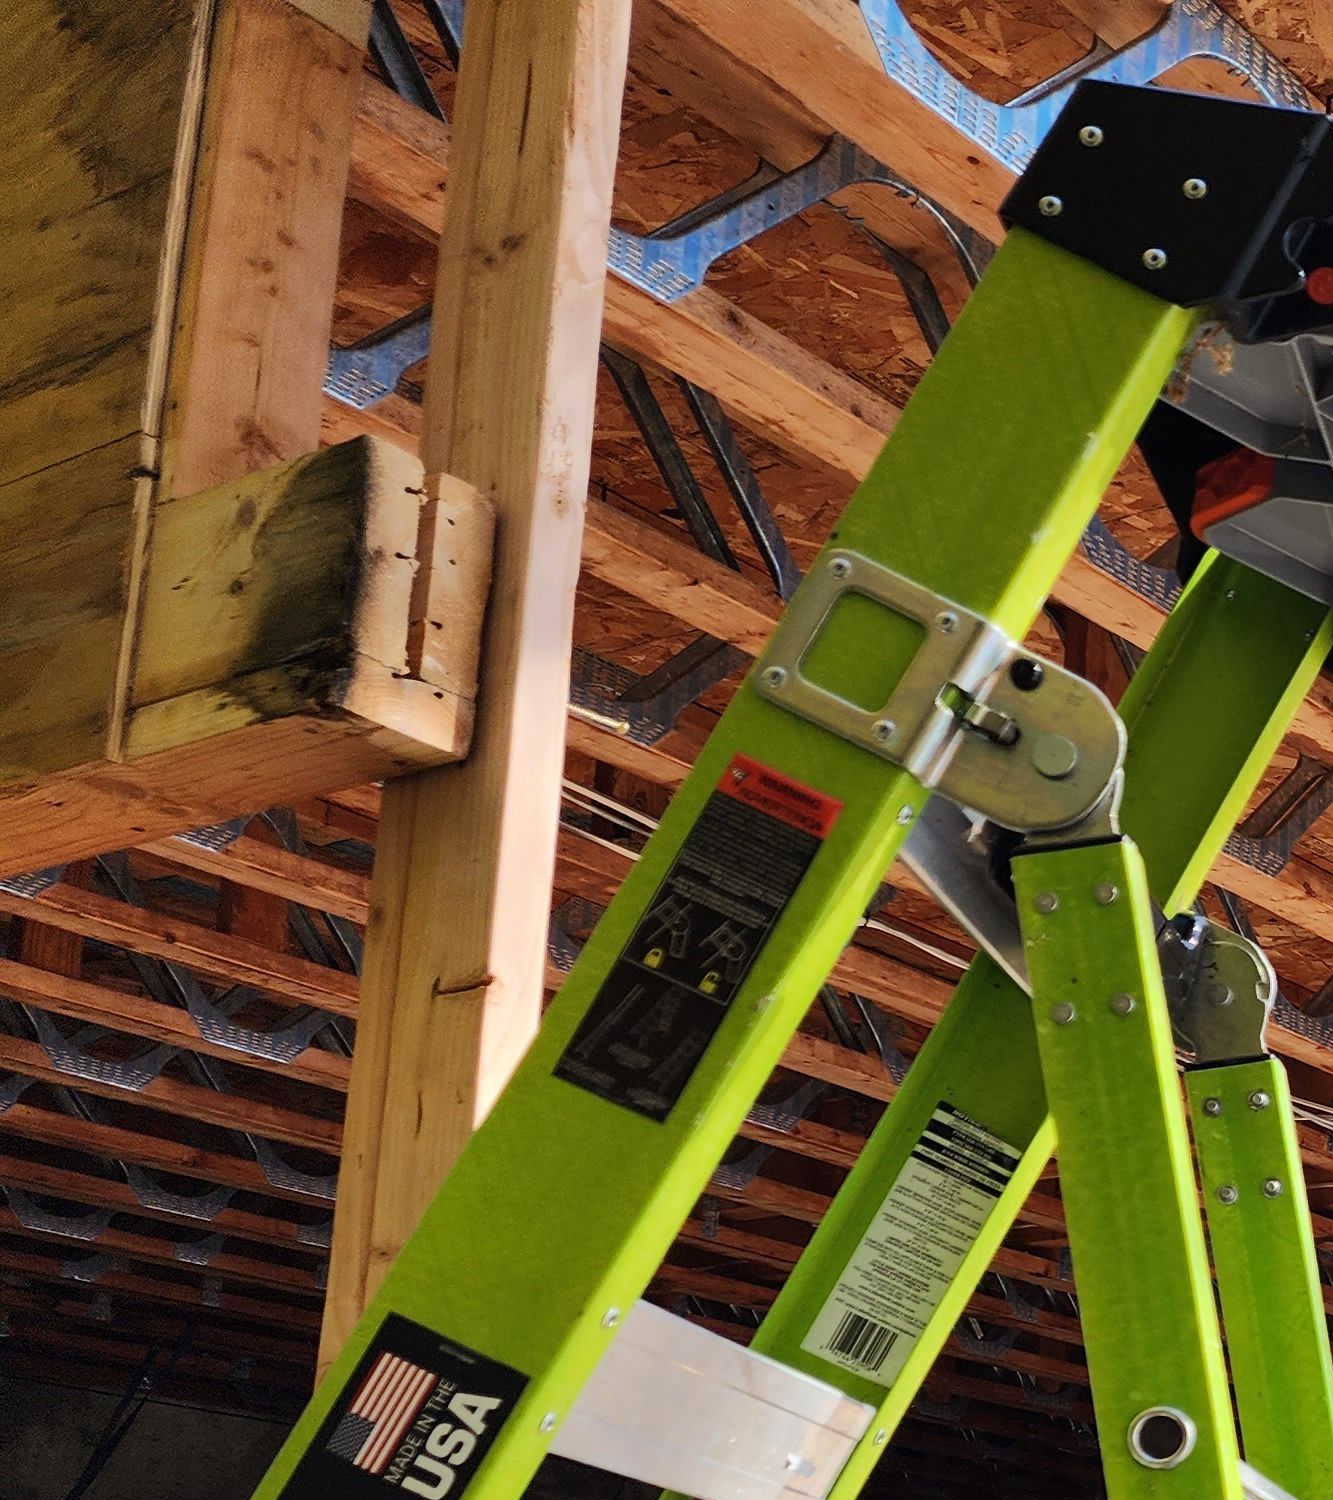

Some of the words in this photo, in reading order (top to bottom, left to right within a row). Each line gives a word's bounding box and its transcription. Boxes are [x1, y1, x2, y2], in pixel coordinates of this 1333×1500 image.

[426, 1377, 457, 1411] THE
[417, 1414, 436, 1434] IN
[384, 1432, 424, 1484] MADE
[401, 1392, 503, 1500] USA
